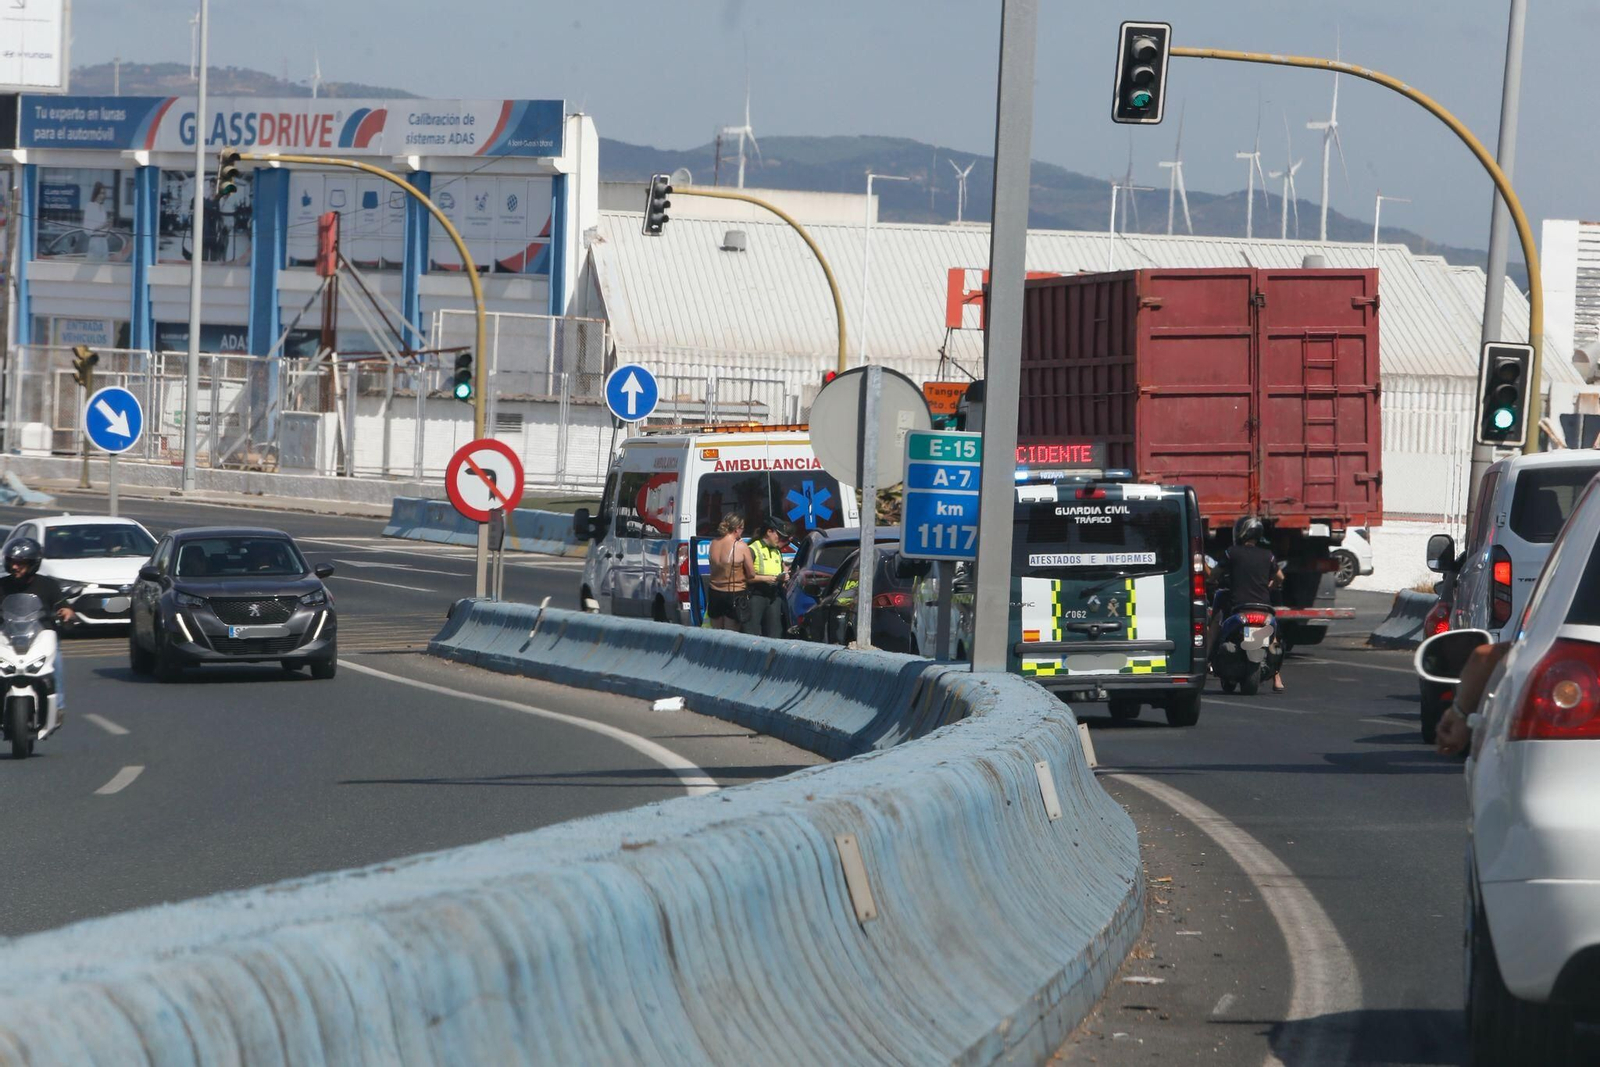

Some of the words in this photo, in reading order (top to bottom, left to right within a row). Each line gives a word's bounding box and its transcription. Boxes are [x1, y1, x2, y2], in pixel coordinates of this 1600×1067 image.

[35, 106, 47, 119] Tu
[49, 107, 85, 122] experto
[87, 110, 99, 120] en
[101, 107, 126, 120] lunas
[408, 113, 460, 126] Calibración
[463, 113, 475, 126] de
[34, 128, 54, 141] para
[57, 127, 66, 139] el
[68, 126, 115, 140] automóvil
[179, 111, 335, 148] GASSDRIVE
[405, 132, 446, 145] sistemas
[448, 132, 475, 145] ADAS
[66, 321, 104, 331] ENTRADA
[930, 439, 976, 458] E-15
[714, 457, 822, 472] AMBULANCIA
[932, 468, 971, 487] A-7
[937, 501, 963, 516] km
[1055, 506, 1102, 516] GUARDIA
[1104, 505, 1130, 515] CIVIL
[1074, 515, 1112, 524] TRÁFICO
[918, 523, 978, 550] 1117
[1030, 555, 1081, 565] ATESTADOS
[1091, 555, 1096, 564] E
[1106, 554, 1153, 564] INFORMES
[1071, 610, 1086, 619] 062
